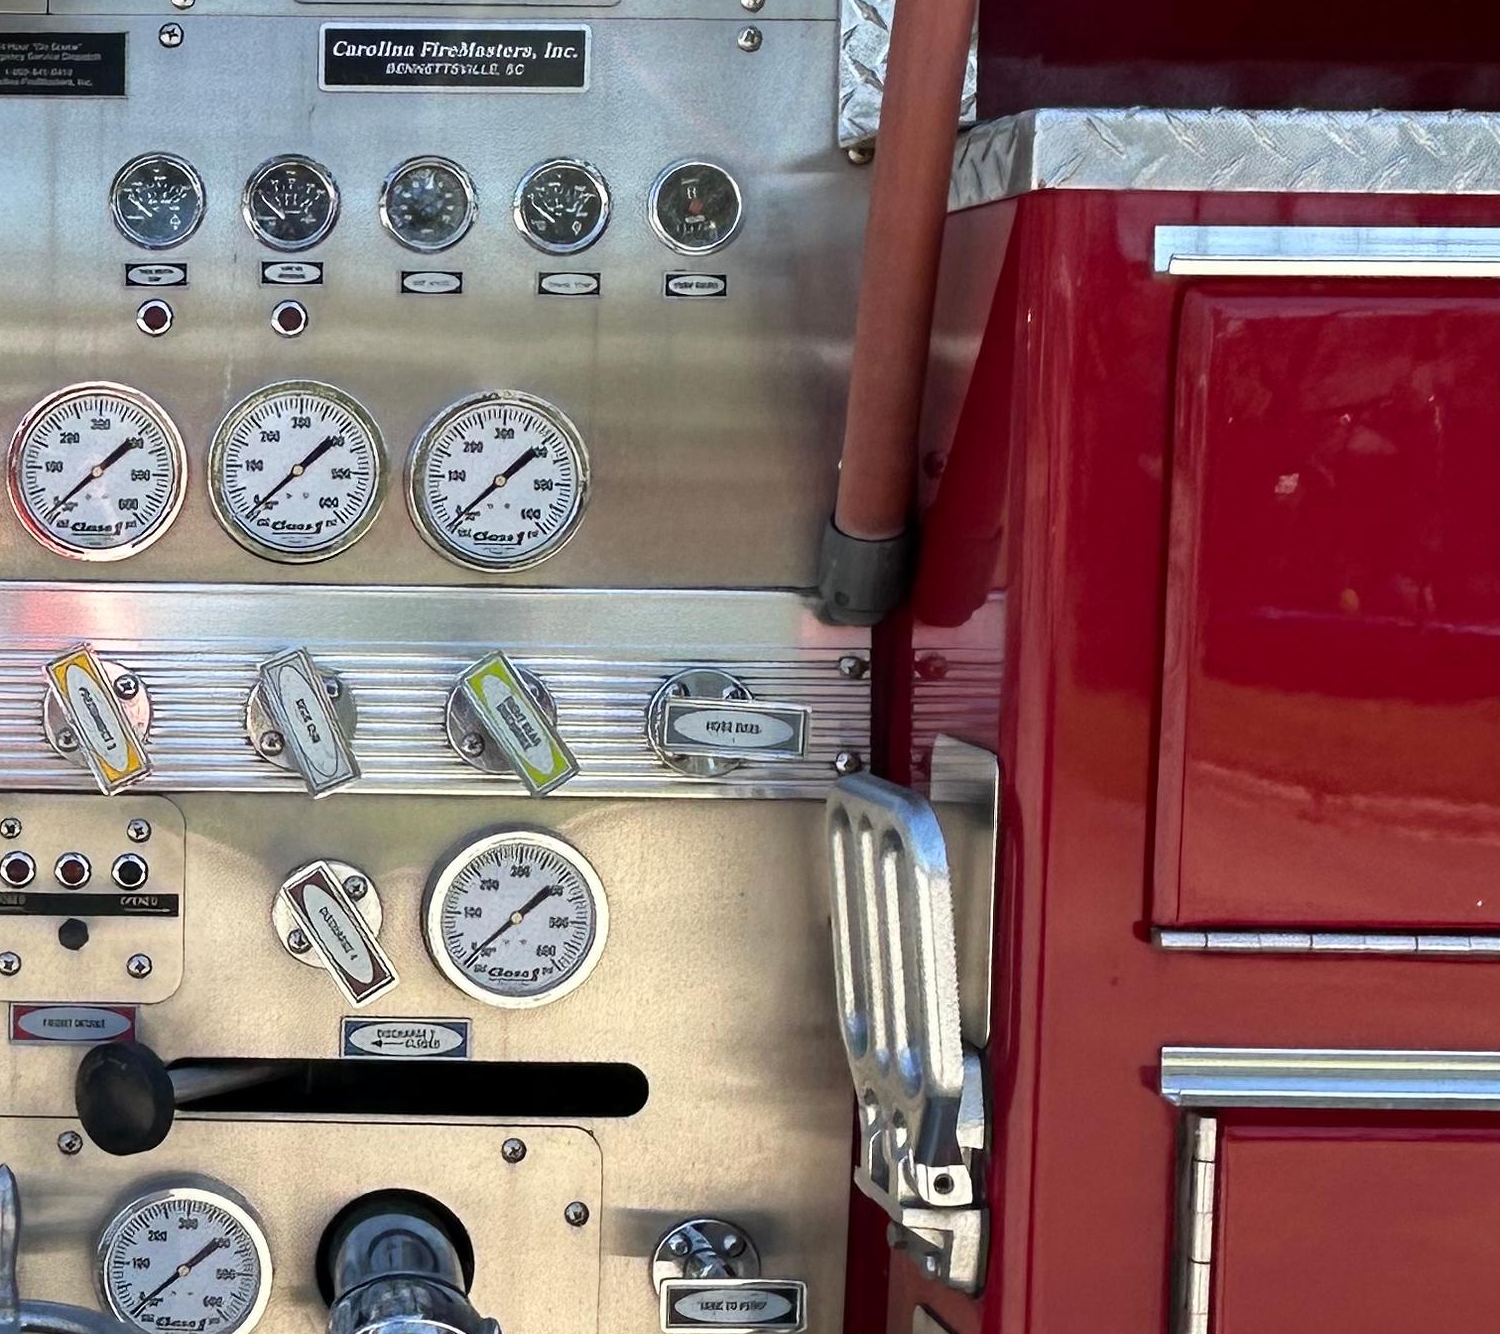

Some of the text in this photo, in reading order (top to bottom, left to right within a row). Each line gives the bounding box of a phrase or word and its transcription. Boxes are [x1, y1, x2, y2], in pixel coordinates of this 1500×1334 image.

[332, 40, 578, 60] Carolina FireMasters, Inc.
